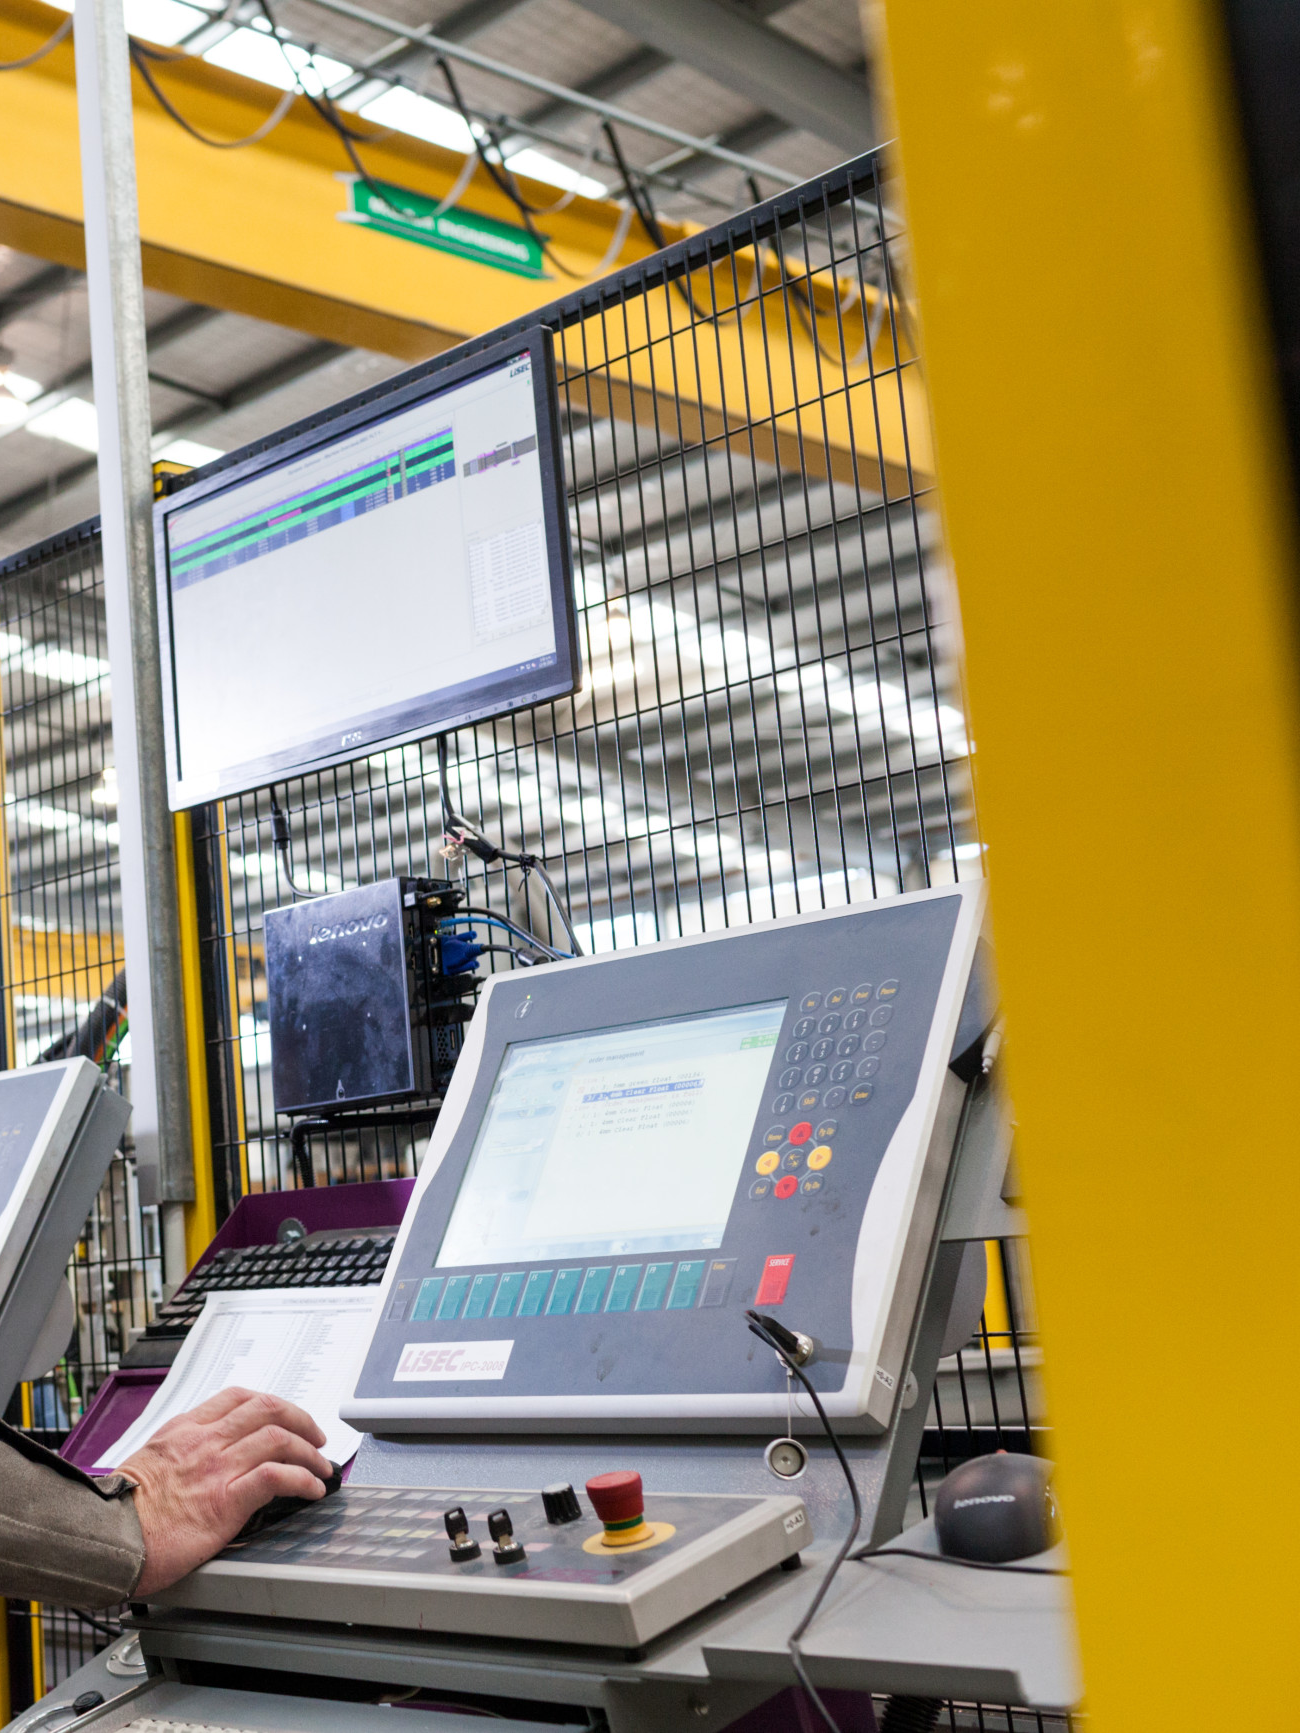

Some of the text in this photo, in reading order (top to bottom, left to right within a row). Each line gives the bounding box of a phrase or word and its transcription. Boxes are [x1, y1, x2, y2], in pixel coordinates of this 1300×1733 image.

[309, 911, 389, 945] lenovo
[768, 1257, 791, 1267] SERVICE
[953, 1494, 1016, 1510] lenovo
